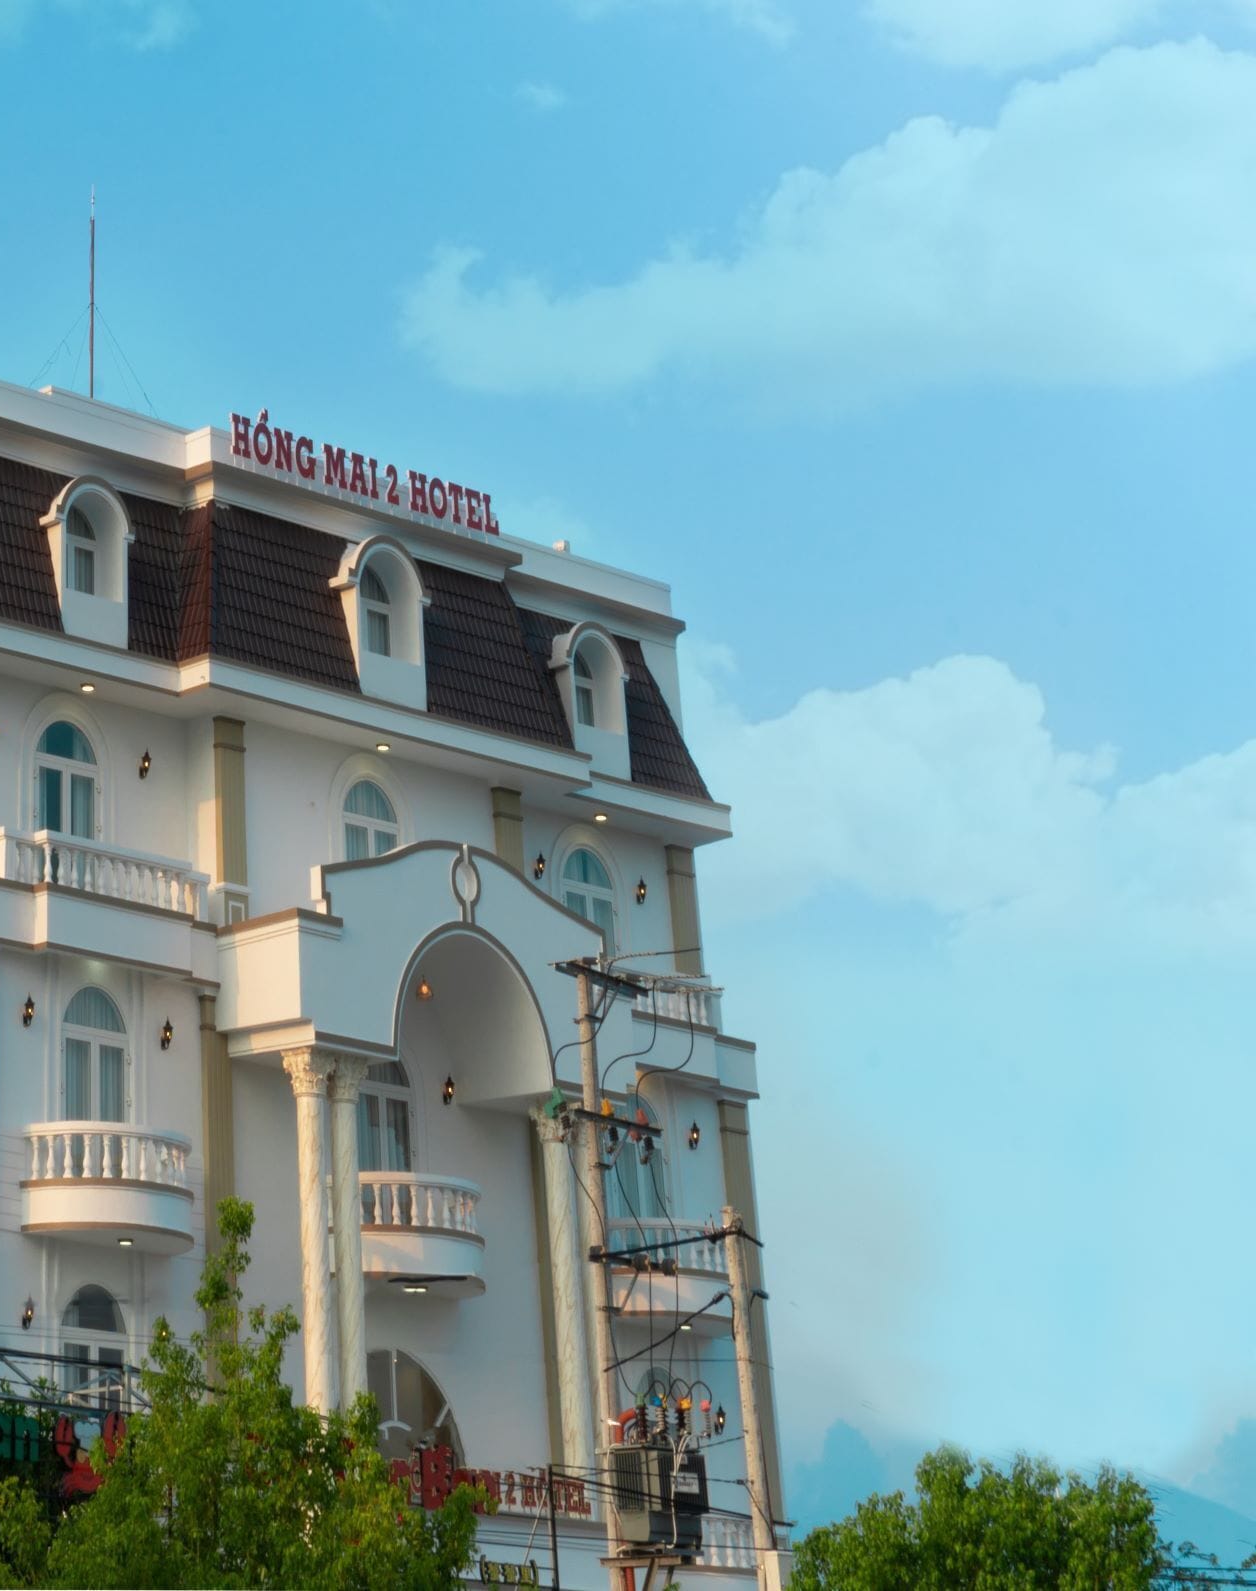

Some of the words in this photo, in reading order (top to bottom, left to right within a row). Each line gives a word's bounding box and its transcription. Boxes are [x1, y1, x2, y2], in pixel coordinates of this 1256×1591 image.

[321, 443, 379, 500] MAI
[384, 464, 400, 506] 2
[407, 469, 500, 536] HOTEL
